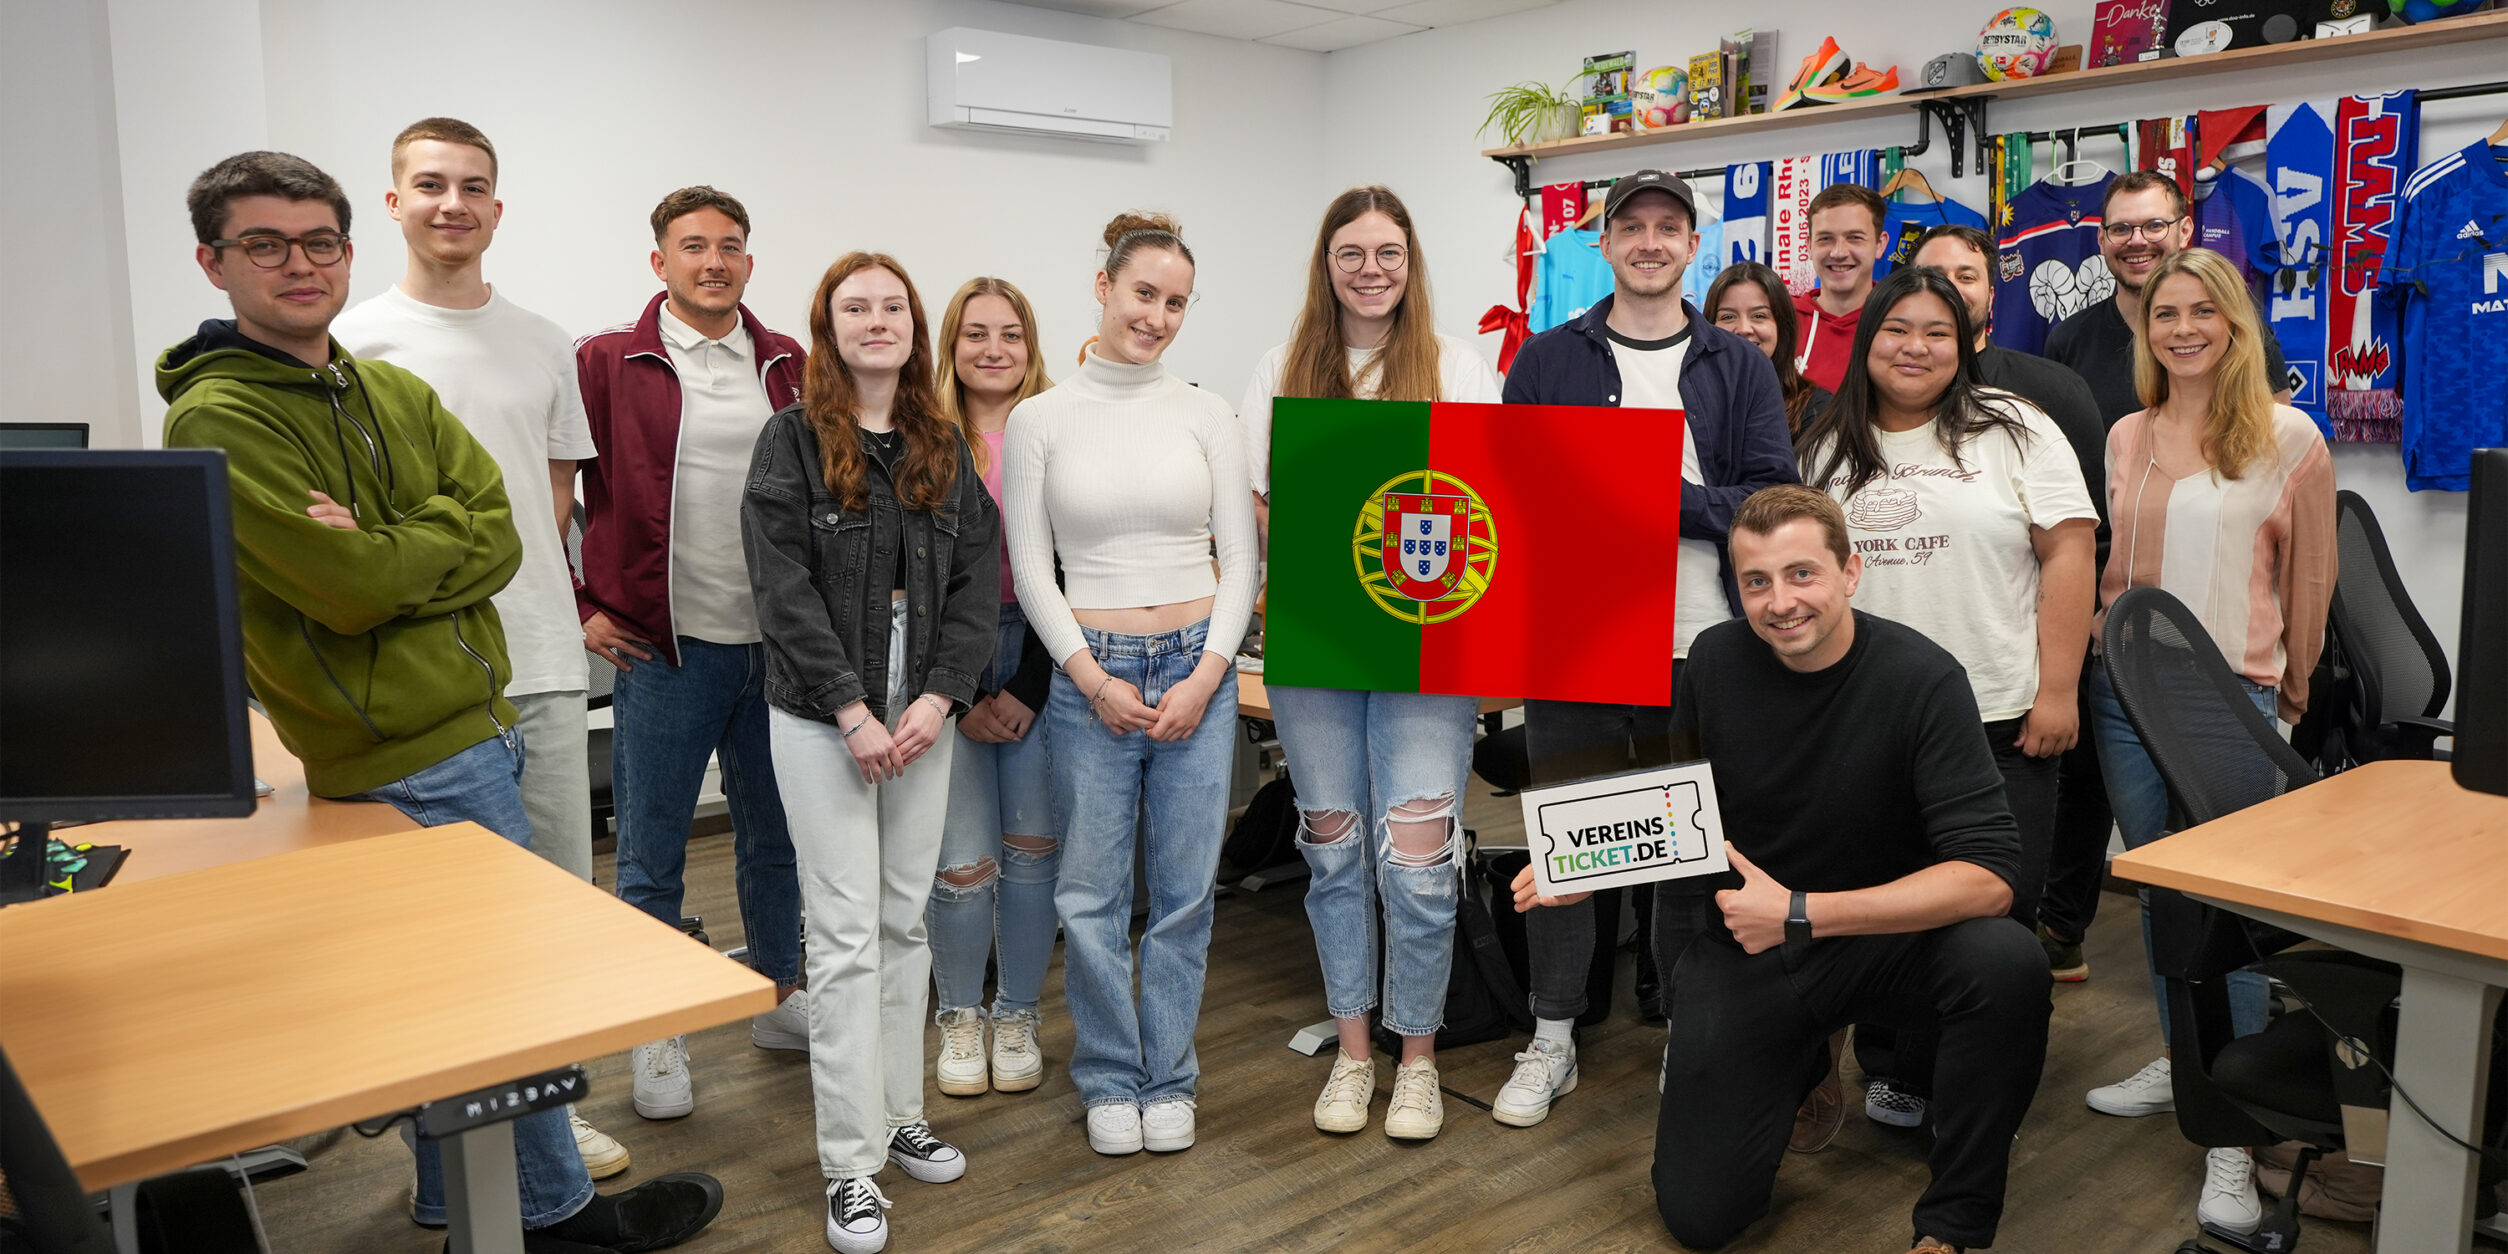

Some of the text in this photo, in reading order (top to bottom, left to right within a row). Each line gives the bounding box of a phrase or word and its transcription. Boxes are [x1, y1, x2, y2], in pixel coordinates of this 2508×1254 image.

[1983, 34, 2027, 45] DERBYSTAR
[2271, 166, 2323, 322] HSV
[2456, 229, 2485, 240] adidas
[2336, 340, 2391, 378] RAMS
[1853, 534, 1950, 554] YORK CAFE
[1910, 551, 1934, 567] 59
[1567, 816, 1665, 848] VEREINS
[1553, 840, 1668, 874] TICKET.DE
